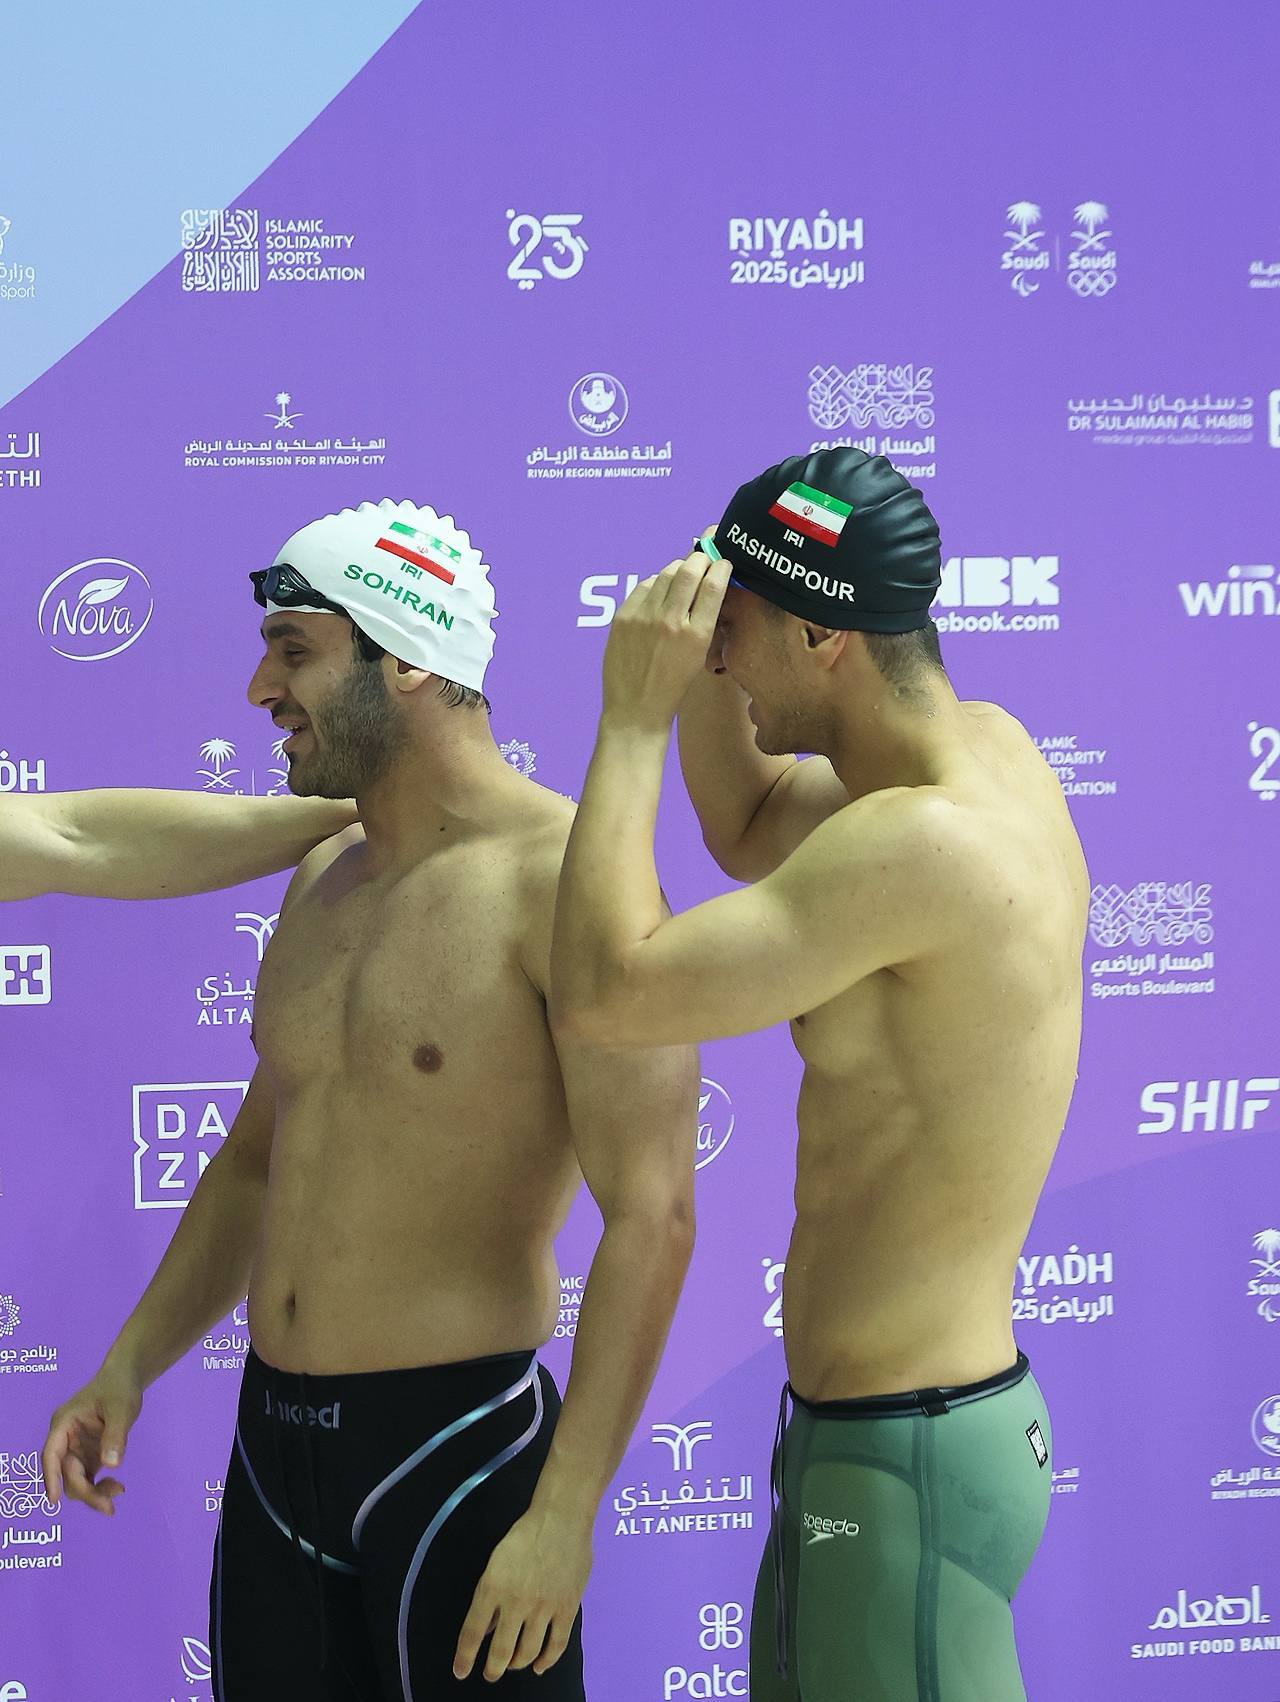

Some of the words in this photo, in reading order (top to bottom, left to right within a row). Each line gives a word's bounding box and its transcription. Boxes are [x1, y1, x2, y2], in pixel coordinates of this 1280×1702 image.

[266, 220, 323, 233] ISLAMIC
[730, 209, 863, 258] RIYADH
[266, 236, 354, 249] SOLIDARITY
[267, 252, 321, 264] SPORTS
[1001, 252, 1049, 269] Saudi
[1068, 252, 1116, 269] Saudi
[267, 267, 364, 280] ASSOCIATION
[731, 261, 788, 283] 2025
[790, 259, 864, 289] الرياض
[1, 284, 35, 300] Sport
[1069, 416, 1091, 430] DR
[1095, 415, 1178, 430] SULAIMAN
[1182, 415, 1201, 429] AL
[1206, 414, 1252, 429] HABIB
[185, 440, 221, 453] الرياض
[226, 440, 271, 452] لمدينة
[276, 439, 330, 452] الملكية
[334, 437, 385, 452] الهيئة
[580, 446, 629, 460] منطقة
[631, 441, 671, 460] أمانة
[878, 435, 936, 457] المسار
[185, 457, 219, 466] ROYAL
[223, 457, 291, 466] COMMISSION
[295, 456, 316, 465] FOR
[319, 456, 359, 465] RIYADH
[363, 455, 385, 464] CITY
[527, 447, 577, 465] الرياض
[528, 469, 563, 478] RIYADH
[566, 468, 602, 477] REGION
[604, 467, 671, 477] MUNICIPALITY
[895, 462, 937, 479] evard
[782, 528, 806, 549] IRI
[399, 562, 424, 581] IRI
[726, 523, 856, 603] RASHIDPOUR
[343, 564, 455, 631] SOHRAN
[1177, 564, 1280, 617] win
[51, 598, 134, 637] Nova
[1034, 735, 1078, 750] LAMIC
[1062, 781, 1117, 796] CIATION
[1158, 952, 1213, 974] المسار
[1091, 983, 1140, 999] Sports
[1142, 979, 1214, 995] Boulevard
[1136, 1077, 1280, 1134] SHIF
[1017, 1244, 1113, 1296] YADH
[1040, 1295, 1113, 1323] الرياض
[20, 1346, 57, 1361] برنامج
[14, 1363, 57, 1372] PROGRAM
[612, 1475, 753, 1513] التنفيذي
[614, 1512, 753, 1535] ALTANFEETHI
[801, 1511, 860, 1538] speedo
[2, 1525, 61, 1549] المسار
[1131, 1642, 1184, 1658] SAUDI
[1189, 1639, 1234, 1654] FOOD
[664, 1663, 749, 1701] Patc
